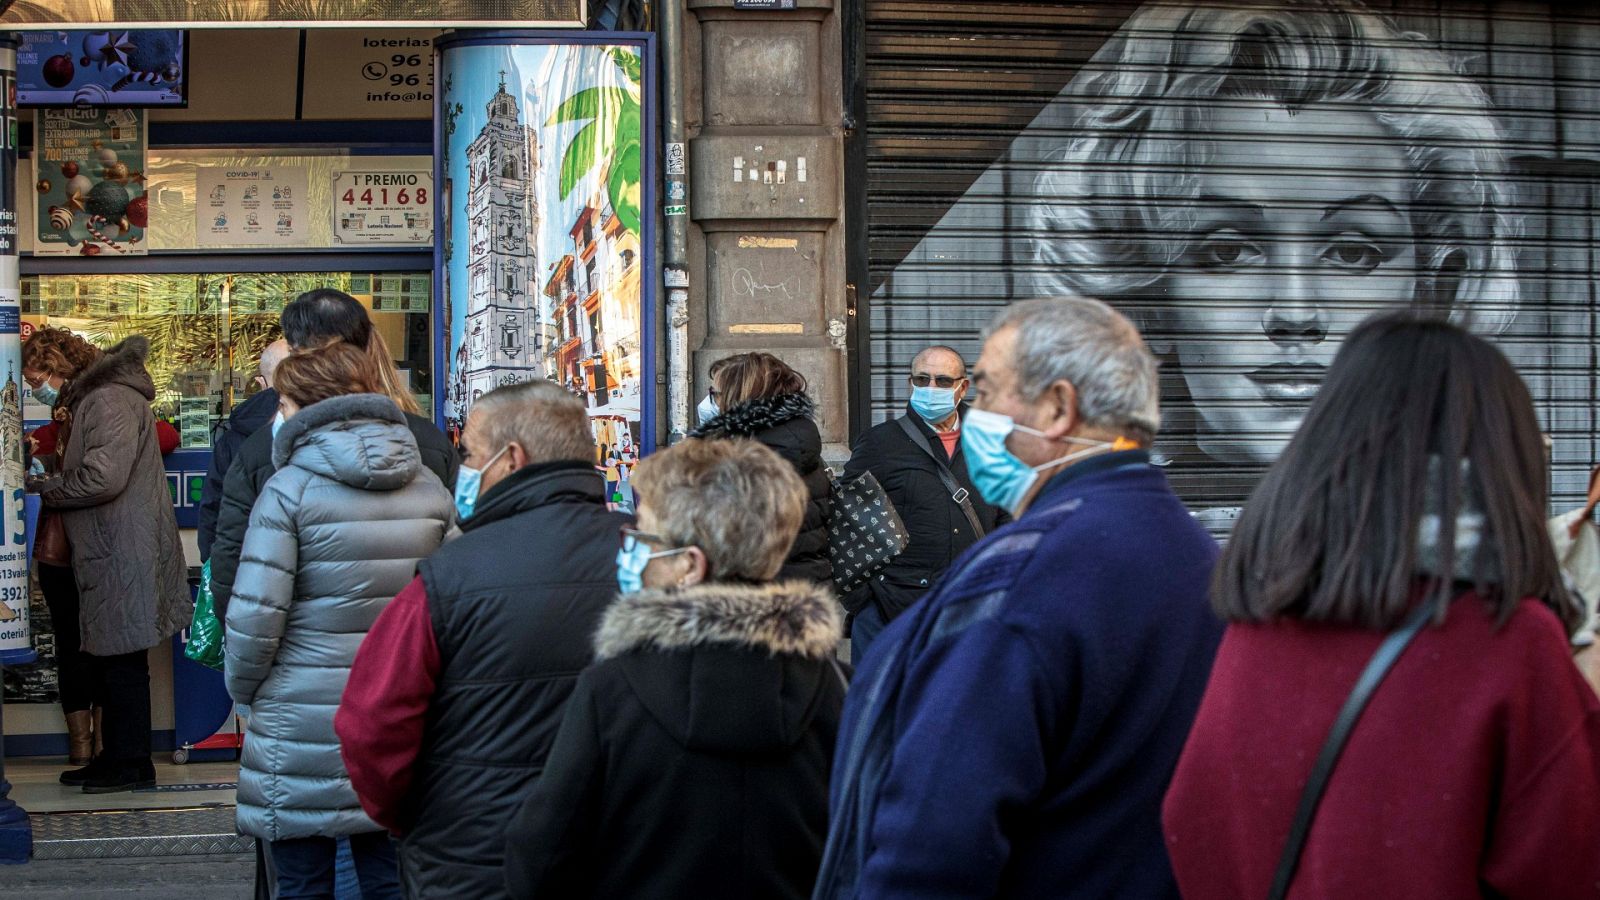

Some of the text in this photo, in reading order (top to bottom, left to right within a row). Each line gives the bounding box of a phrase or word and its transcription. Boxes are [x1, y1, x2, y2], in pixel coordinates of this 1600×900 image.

[364, 37, 430, 48] loterias
[391, 54, 421, 67] 96
[390, 73, 420, 86] 96
[45, 129, 101, 138] EXTRAORDINARIO
[45, 148, 62, 161] 700
[365, 174, 418, 186] PREMIO
[342, 188, 428, 205] 44168
[2, 586, 22, 602] 392
